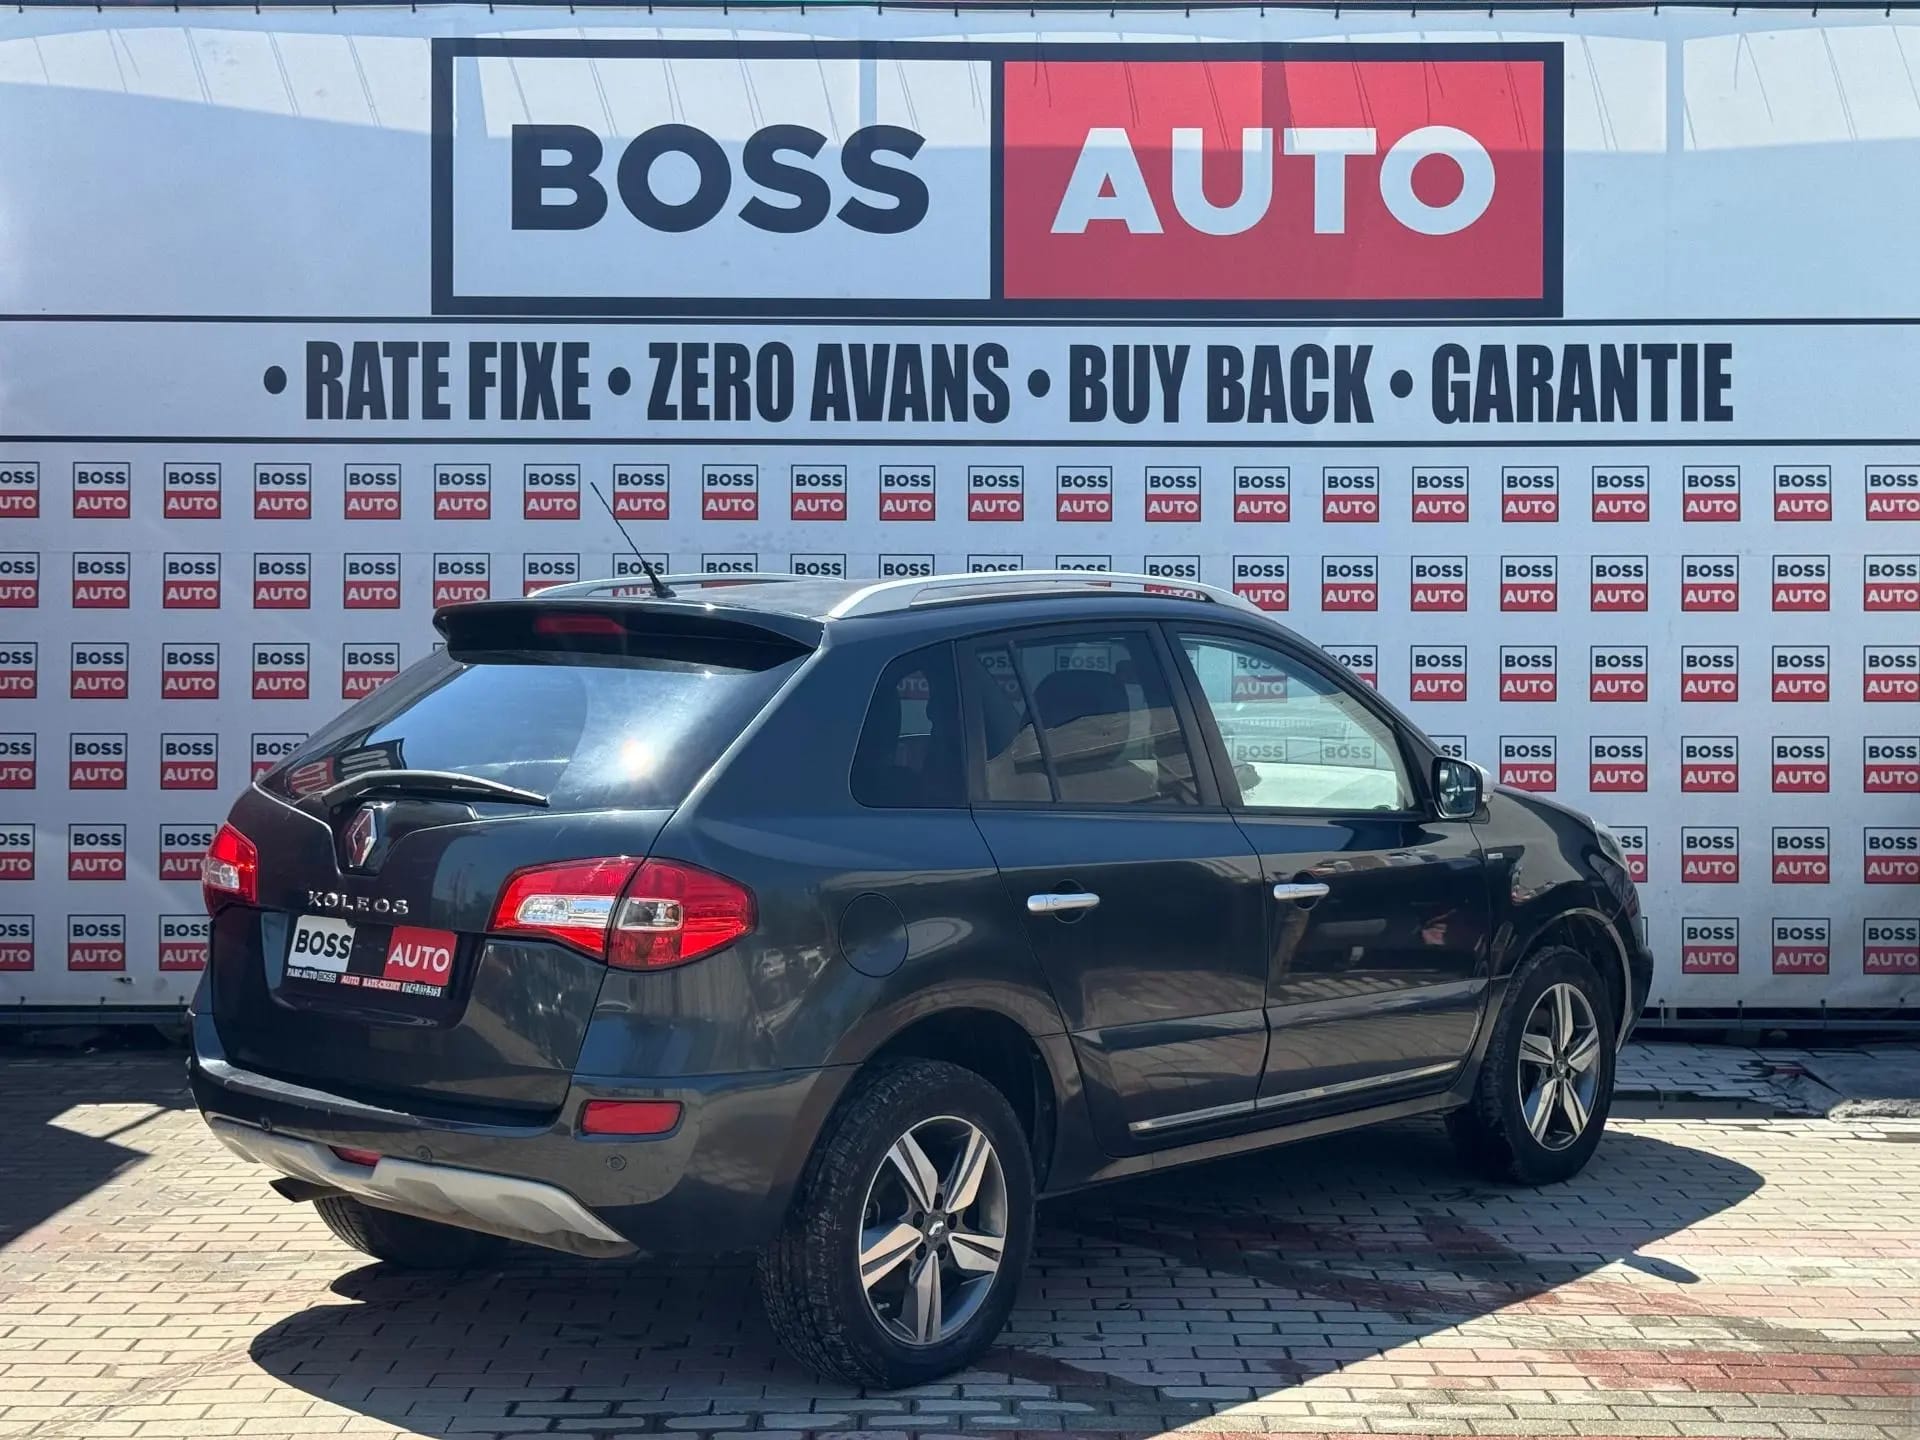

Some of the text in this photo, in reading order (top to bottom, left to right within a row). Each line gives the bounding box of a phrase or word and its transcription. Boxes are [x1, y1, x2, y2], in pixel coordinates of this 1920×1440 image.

[512, 124, 1495, 235] BOSS AUTO
[307, 341, 1733, 424] RATE FIXE ZERO AVANS BUY BACK GARANTIE
[78, 472, 126, 484] BOSS
[168, 472, 216, 484] BOSS
[260, 472, 308, 486] BOSS
[350, 472, 396, 486] BOSS
[438, 472, 486, 486] BOSS
[528, 472, 576, 486] BOSS
[618, 472, 664, 486] BOSS
[706, 474, 754, 486] BOSS
[796, 474, 842, 486] BOSS
[884, 474, 930, 488] BOSS
[972, 474, 1020, 488] BOSS
[1060, 474, 1108, 488] BOSS
[1150, 476, 1196, 488] BOSS
[1238, 476, 1286, 488] BOSS
[1328, 476, 1374, 488] BOSS
[1416, 476, 1464, 488] BOSS
[1506, 476, 1554, 488] BOSS
[1598, 474, 1646, 488] BOSS
[1688, 474, 1736, 488] BOSS
[1780, 474, 1828, 488] BOSS
[1870, 474, 1918, 486] BOSS
[76, 496, 128, 510] AUTO
[166, 496, 218, 510] AUTO
[258, 498, 309, 511] AUTO
[348, 498, 398, 511] AUTO
[436, 498, 487, 511] AUTO
[526, 498, 577, 511] AUTO
[616, 498, 666, 511] AUTO
[704, 498, 755, 512] AUTO
[794, 498, 844, 512] AUTO
[882, 500, 932, 513] AUTO
[970, 500, 1021, 513] AUTO
[1058, 500, 1109, 513] AUTO
[1148, 500, 1198, 514] AUTO
[1236, 500, 1287, 514] AUTO
[1326, 500, 1376, 514] AUTO
[1414, 500, 1465, 514] AUTO
[1504, 500, 1555, 514] AUTO
[1596, 500, 1647, 513] AUTO
[1686, 500, 1738, 513] AUTO
[1778, 500, 1829, 513] AUTO
[1868, 498, 1920, 512] AUTO
[78, 562, 126, 574] BOSS
[168, 562, 216, 574] BOSS
[258, 562, 306, 574] BOSS
[348, 562, 396, 574] BOSS
[438, 562, 486, 574] BOSS
[528, 562, 574, 574] BOSS
[706, 562, 753, 573] BOSS
[794, 562, 842, 576] BOSS
[884, 564, 930, 576] BOSS
[1148, 564, 1196, 577] BOSS
[1238, 564, 1284, 578] BOSS
[1326, 564, 1374, 578] BOSS
[1416, 564, 1462, 578] BOSS
[1506, 564, 1552, 578] BOSS
[1596, 564, 1644, 578] BOSS
[1686, 564, 1734, 578] BOSS
[1778, 564, 1826, 578] BOSS
[1868, 564, 1916, 576] BOSS
[76, 586, 127, 600] AUTO
[166, 586, 218, 600] AUTO
[256, 586, 308, 600] AUTO
[346, 586, 397, 600] AUTO
[436, 586, 487, 600] AUTO
[1236, 590, 1286, 603] AUTO
[1324, 590, 1375, 603] AUTO
[1414, 590, 1464, 603] AUTO
[1504, 590, 1554, 603] AUTO
[1594, 590, 1645, 603] AUTO
[1684, 590, 1736, 603] AUTO
[1776, 590, 1827, 603] AUTO
[1866, 588, 1918, 602] AUTO
[76, 652, 124, 664] BOSS
[168, 652, 216, 664] BOSS
[258, 652, 306, 666] BOSS
[348, 652, 394, 664] BOSS
[1237, 656, 1273, 669] BOS
[1416, 654, 1462, 668] BOSS
[1504, 654, 1552, 668] BOSS
[1596, 654, 1644, 668] BOSS
[1686, 654, 1734, 668] BOSS
[1778, 654, 1826, 668] BOSS
[1868, 654, 1916, 668] BOSS
[74, 676, 126, 690] AUTO
[166, 676, 217, 690] AUTO
[256, 678, 307, 691] AUTO
[1235, 682, 1284, 695] AUTO
[1414, 680, 1464, 693] AUTO
[1502, 680, 1553, 693] AUTO
[1594, 680, 1645, 693] AUTO
[1684, 680, 1736, 693] AUTO
[1776, 680, 1827, 693] AUTO
[1866, 680, 1918, 693] AUTO
[74, 742, 122, 756] BOSS
[166, 742, 214, 756] BOSS
[1237, 746, 1283, 758] BOSS
[1325, 746, 1372, 759] BOSS
[1504, 744, 1552, 758] BOSS
[1596, 744, 1644, 758] BOSS
[1686, 746, 1734, 758] BOSS
[1778, 746, 1826, 758] BOSS
[1868, 746, 1916, 758] BOSS
[72, 768, 124, 781] AUTO
[164, 768, 215, 781] AUTO
[1502, 770, 1553, 783] AUTO
[1594, 770, 1645, 783] AUTO
[1684, 770, 1736, 784] AUTO
[1776, 770, 1827, 784] AUTO
[1866, 770, 1918, 784] AUTO
[74, 832, 122, 846] BOSS
[164, 832, 212, 846] BOSS
[1686, 836, 1734, 848] BOSS
[1778, 836, 1826, 850] BOSS
[1870, 836, 1918, 850] BOSS
[72, 858, 123, 871] AUTO
[1684, 860, 1736, 874] AUTO
[1776, 862, 1827, 875] AUTO
[1868, 862, 1919, 875] AUTO
[308, 890, 409, 915] KOLEOS
[74, 924, 122, 936] BOSS
[1686, 926, 1734, 940] BOSS
[1778, 926, 1826, 940] BOSS
[1868, 928, 1916, 940] BOSS
[72, 948, 123, 962] AUTO
[295, 929, 449, 973] BOSS AUTO
[1684, 952, 1736, 965] AUTO
[1776, 952, 1827, 965] AUTO
[1866, 952, 1918, 966] AUTO
